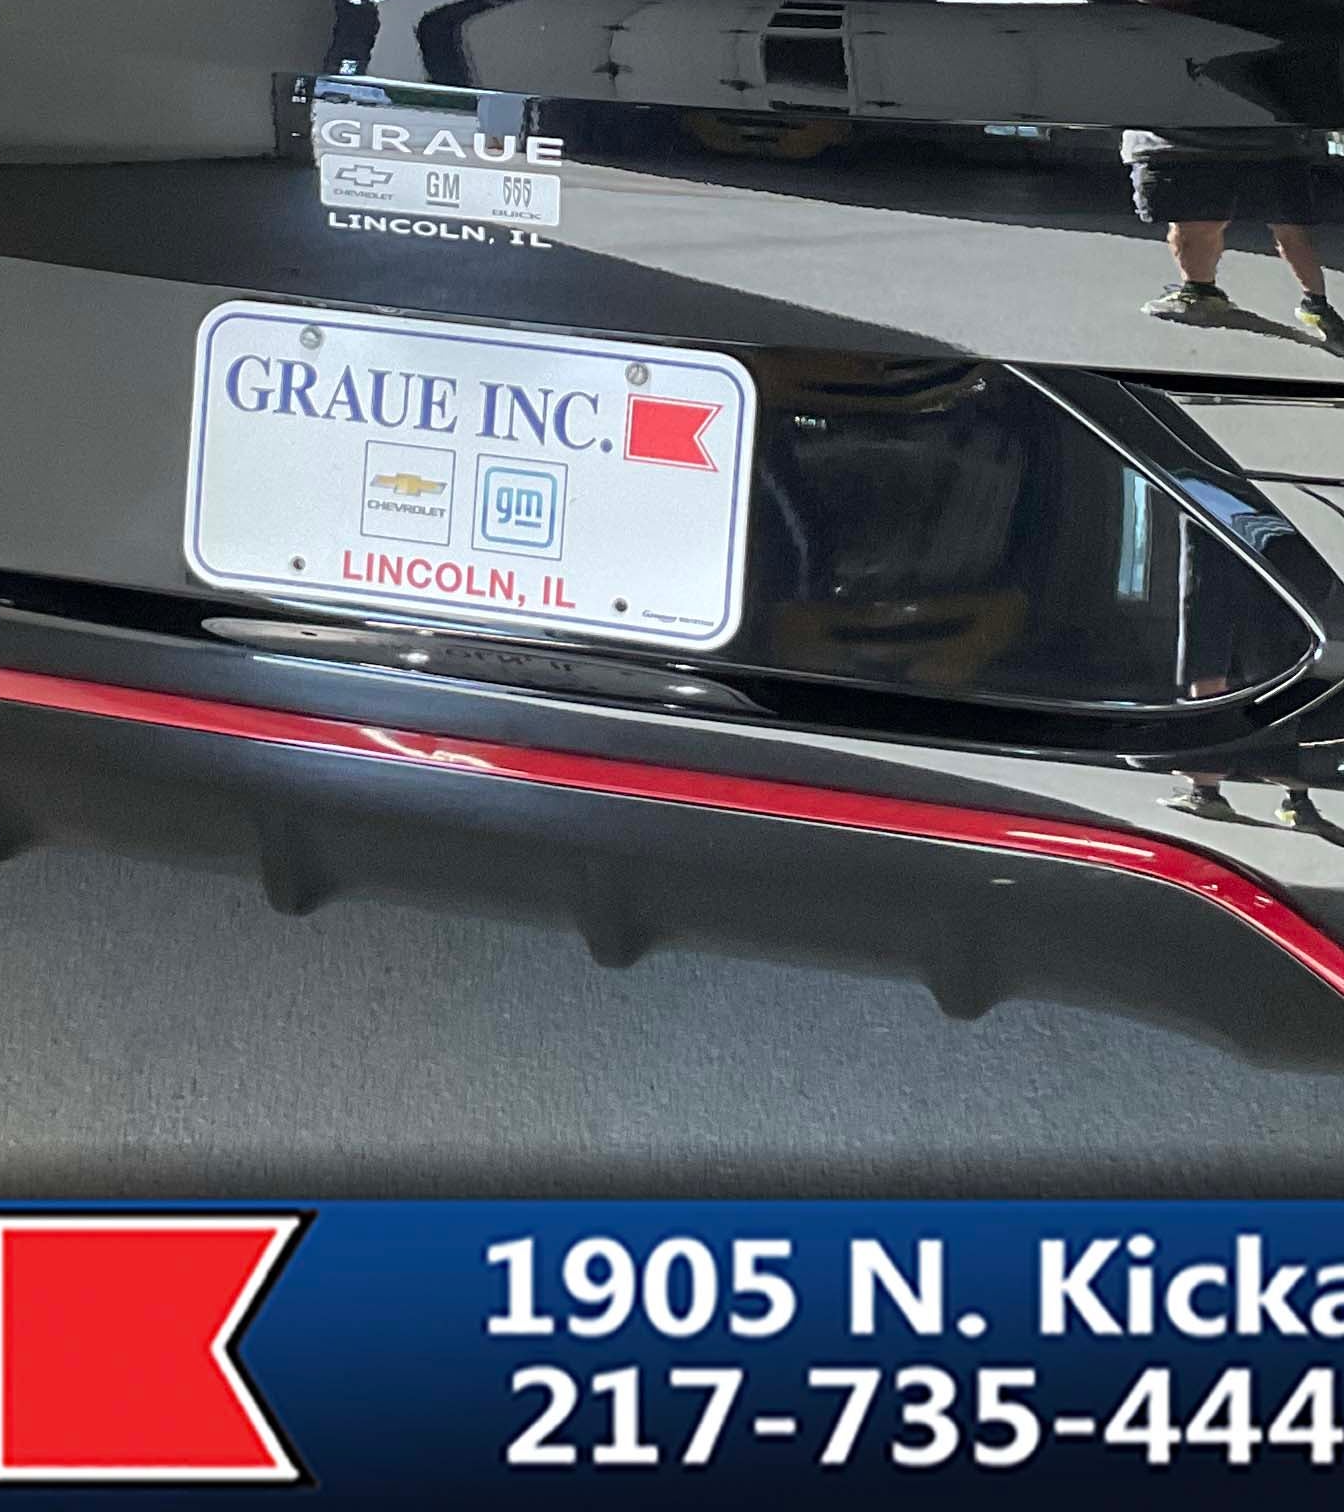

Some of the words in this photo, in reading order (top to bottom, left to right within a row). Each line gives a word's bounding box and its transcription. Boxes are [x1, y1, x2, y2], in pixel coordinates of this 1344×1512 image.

[320, 118, 565, 167] GRAUE
[332, 188, 394, 202] CHEVROLET
[424, 170, 461, 202] GM
[328, 212, 496, 245] LINCOLN,
[509, 229, 553, 248] IL
[491, 207, 542, 221] BUICK
[224, 353, 458, 433] GRAUE
[474, 380, 614, 454] INC.
[366, 498, 447, 518] CHEVROLET
[495, 484, 544, 524] gm
[341, 549, 527, 608] LINCOLN,
[541, 575, 576, 609] IL
